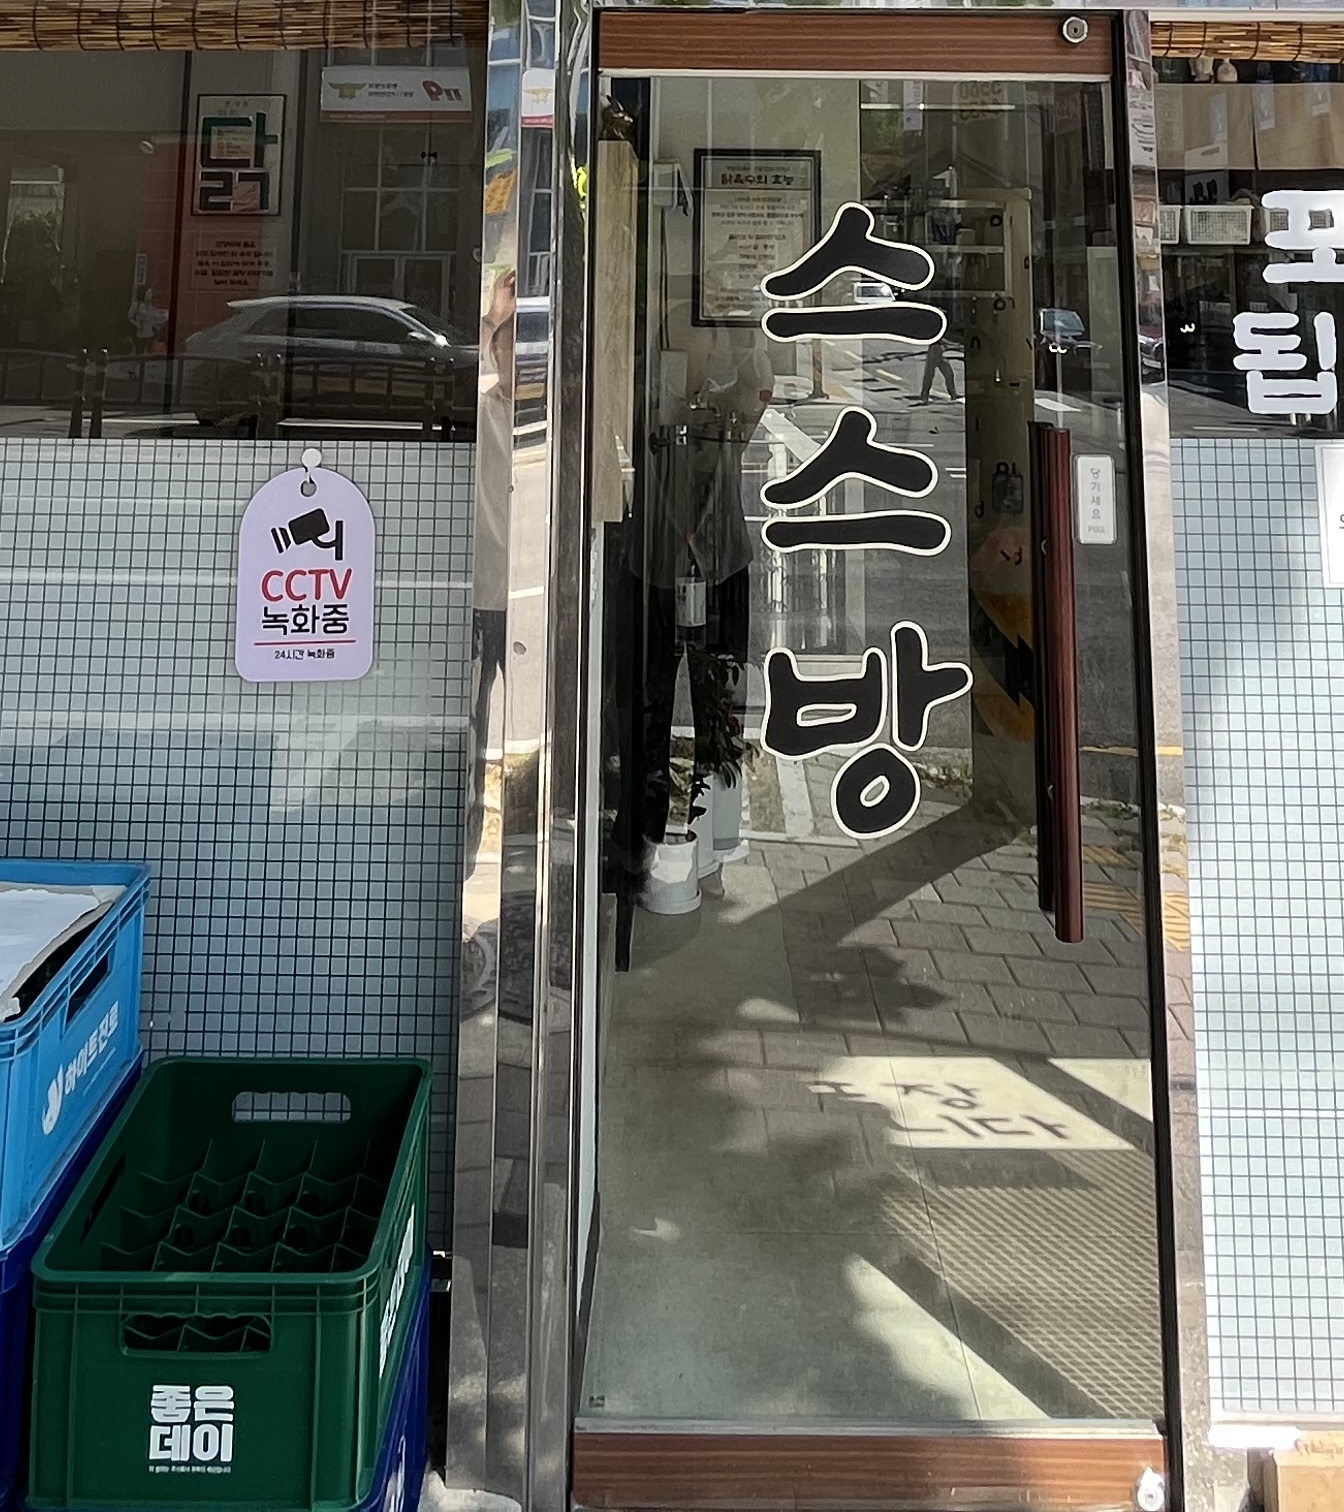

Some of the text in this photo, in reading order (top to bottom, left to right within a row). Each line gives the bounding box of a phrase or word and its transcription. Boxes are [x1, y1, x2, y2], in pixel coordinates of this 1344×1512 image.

[1090, 468, 1102, 519] 당기세요
[761, 202, 973, 839] 스스방
[261, 569, 352, 602] CCTV
[261, 604, 349, 635] 녹화중
[274, 648, 335, 660] 24시간 녹화중
[150, 1384, 235, 1423] 좋은
[149, 1423, 234, 1462] 데이
